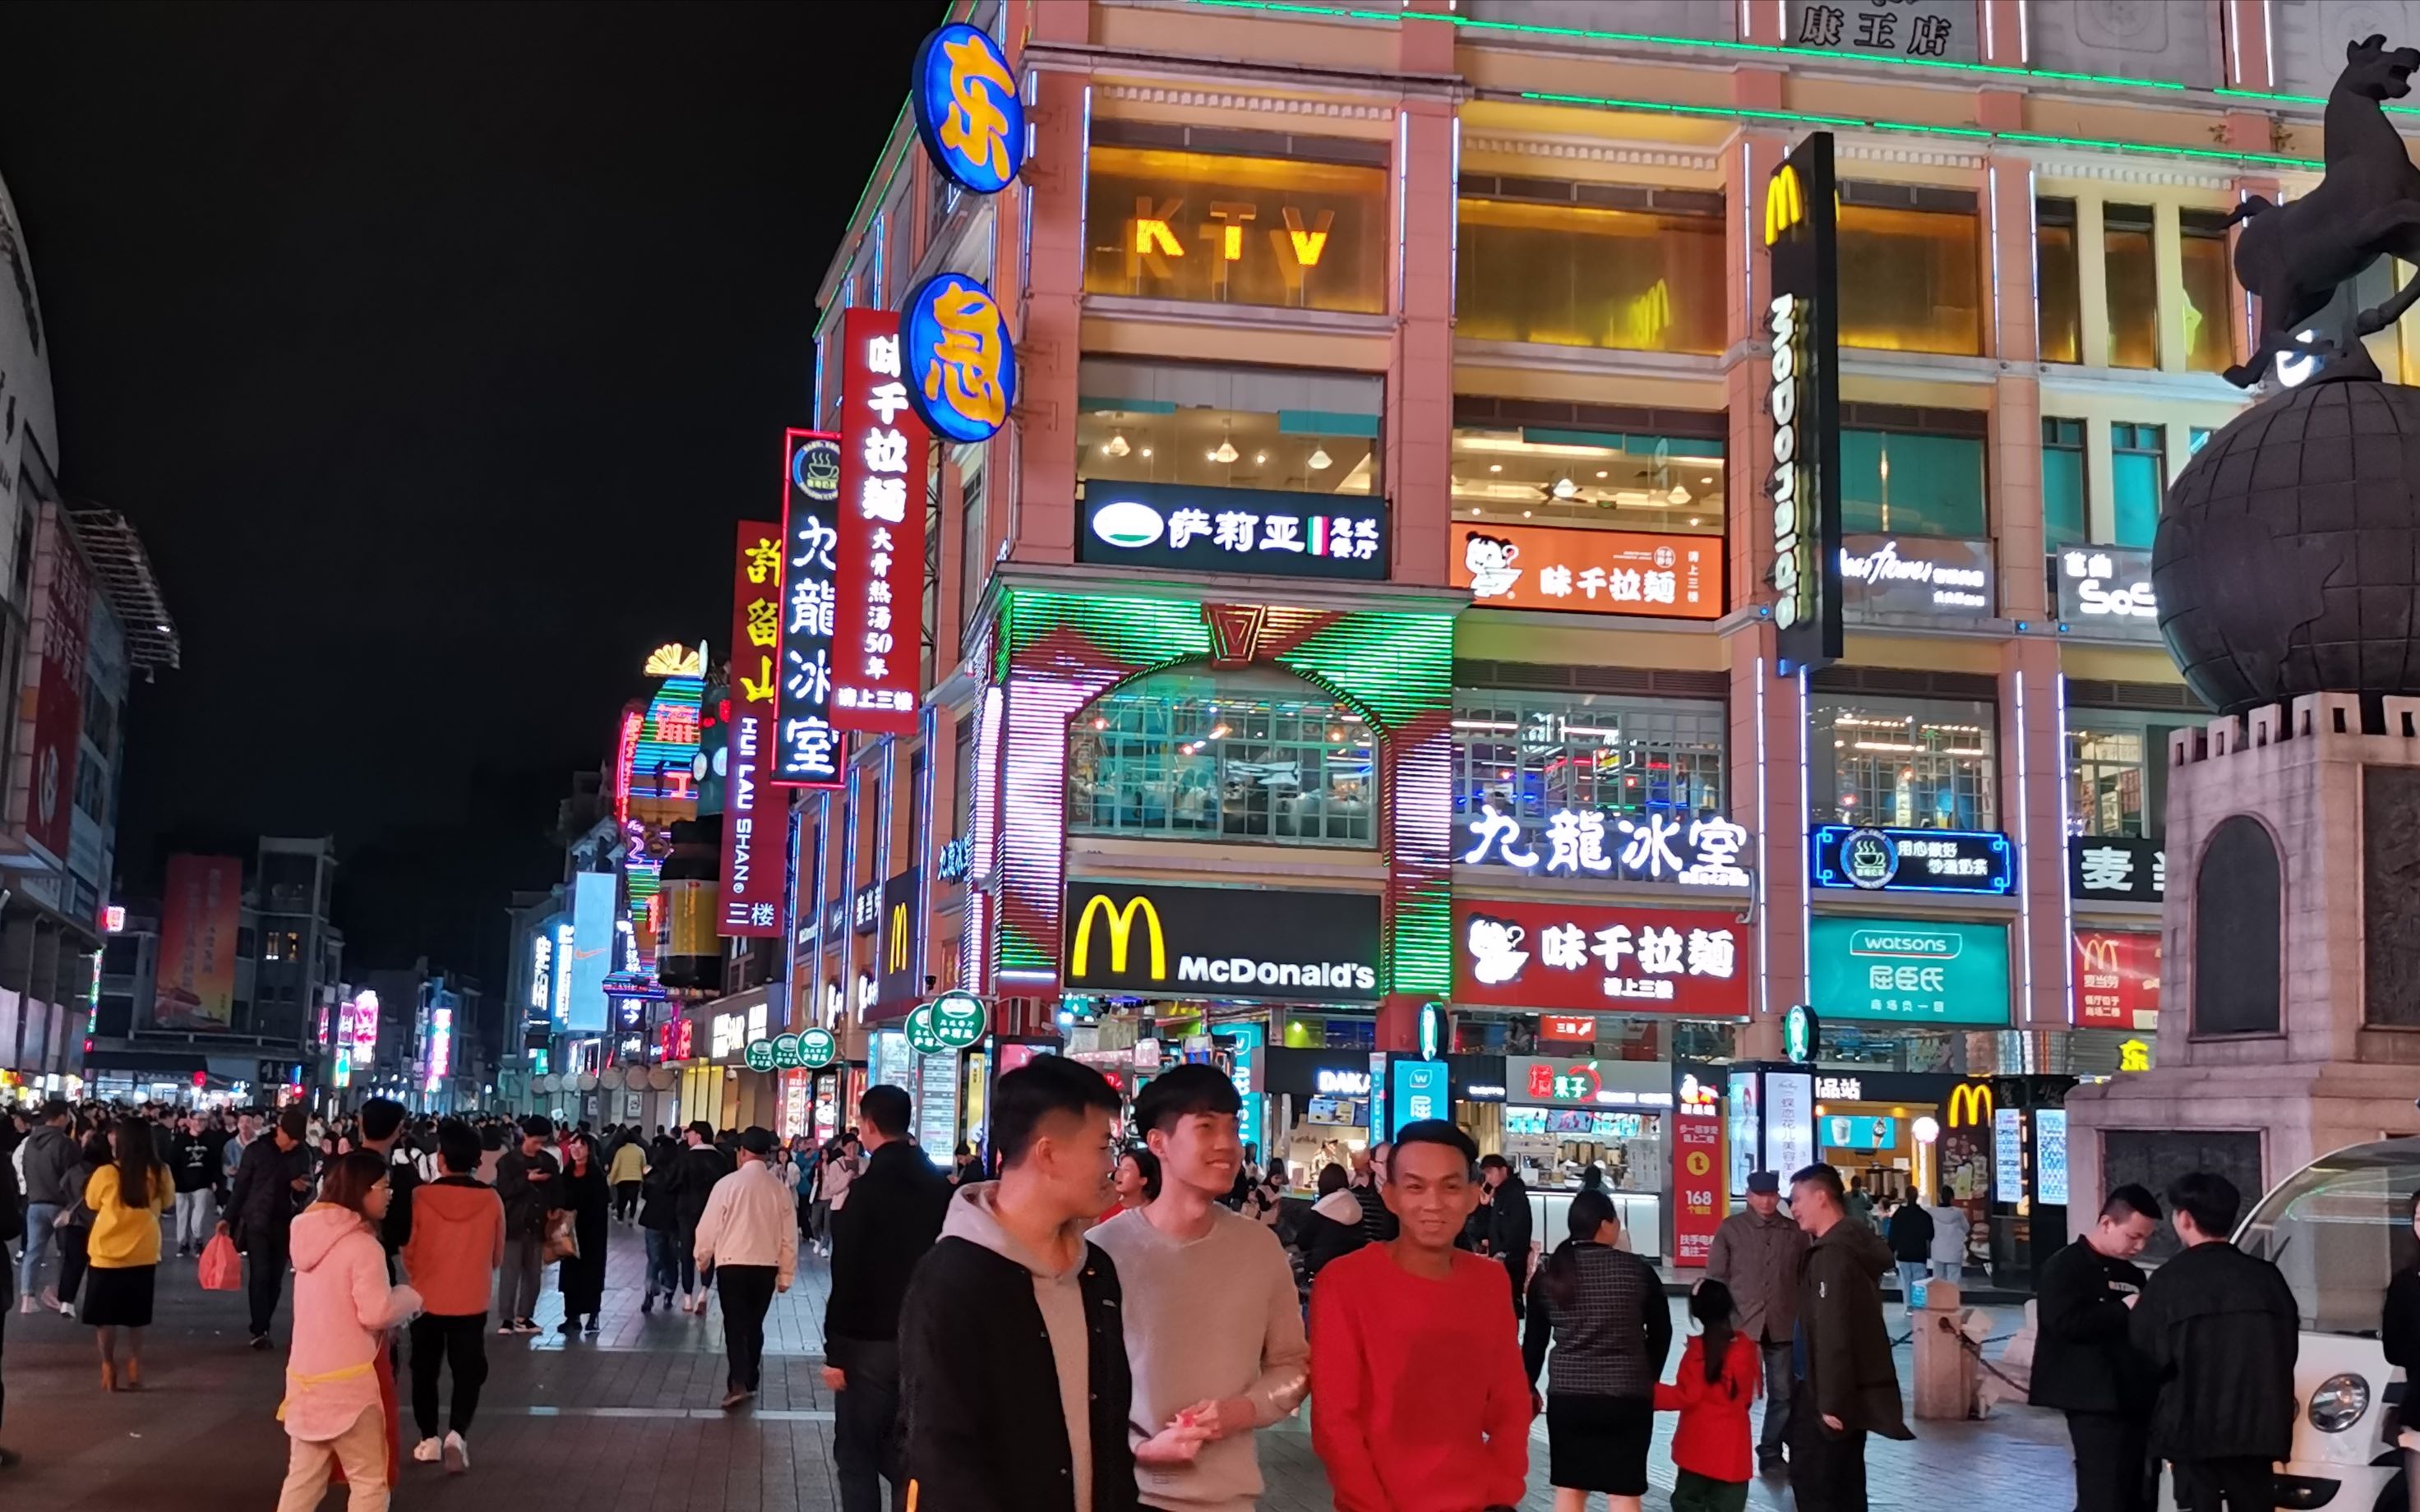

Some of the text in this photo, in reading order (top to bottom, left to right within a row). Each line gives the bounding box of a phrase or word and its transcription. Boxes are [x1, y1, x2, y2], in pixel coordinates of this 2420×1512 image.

[1799, 6, 1951, 56] 康王店
[1136, 197, 1335, 265] KTV
[1771, 293, 1799, 631] McDonald's
[1168, 508, 1305, 552] 萨莉亚
[1540, 564, 1675, 604] 味千拉麵
[740, 717, 758, 757] HUI
[737, 766, 755, 809] LAU
[1465, 804, 1747, 877] 九龍冰室
[2081, 846, 2164, 892] 麦
[726, 902, 775, 927] 三楼
[1541, 922, 1734, 978] 味千拉麵
[1864, 936, 1947, 952] watsons
[1177, 956, 1375, 989] McDonald's
[1868, 966, 1944, 992] 屈臣氏
[2084, 974, 2119, 989] 麦当劳
[1685, 1190, 1712, 1205] 168
